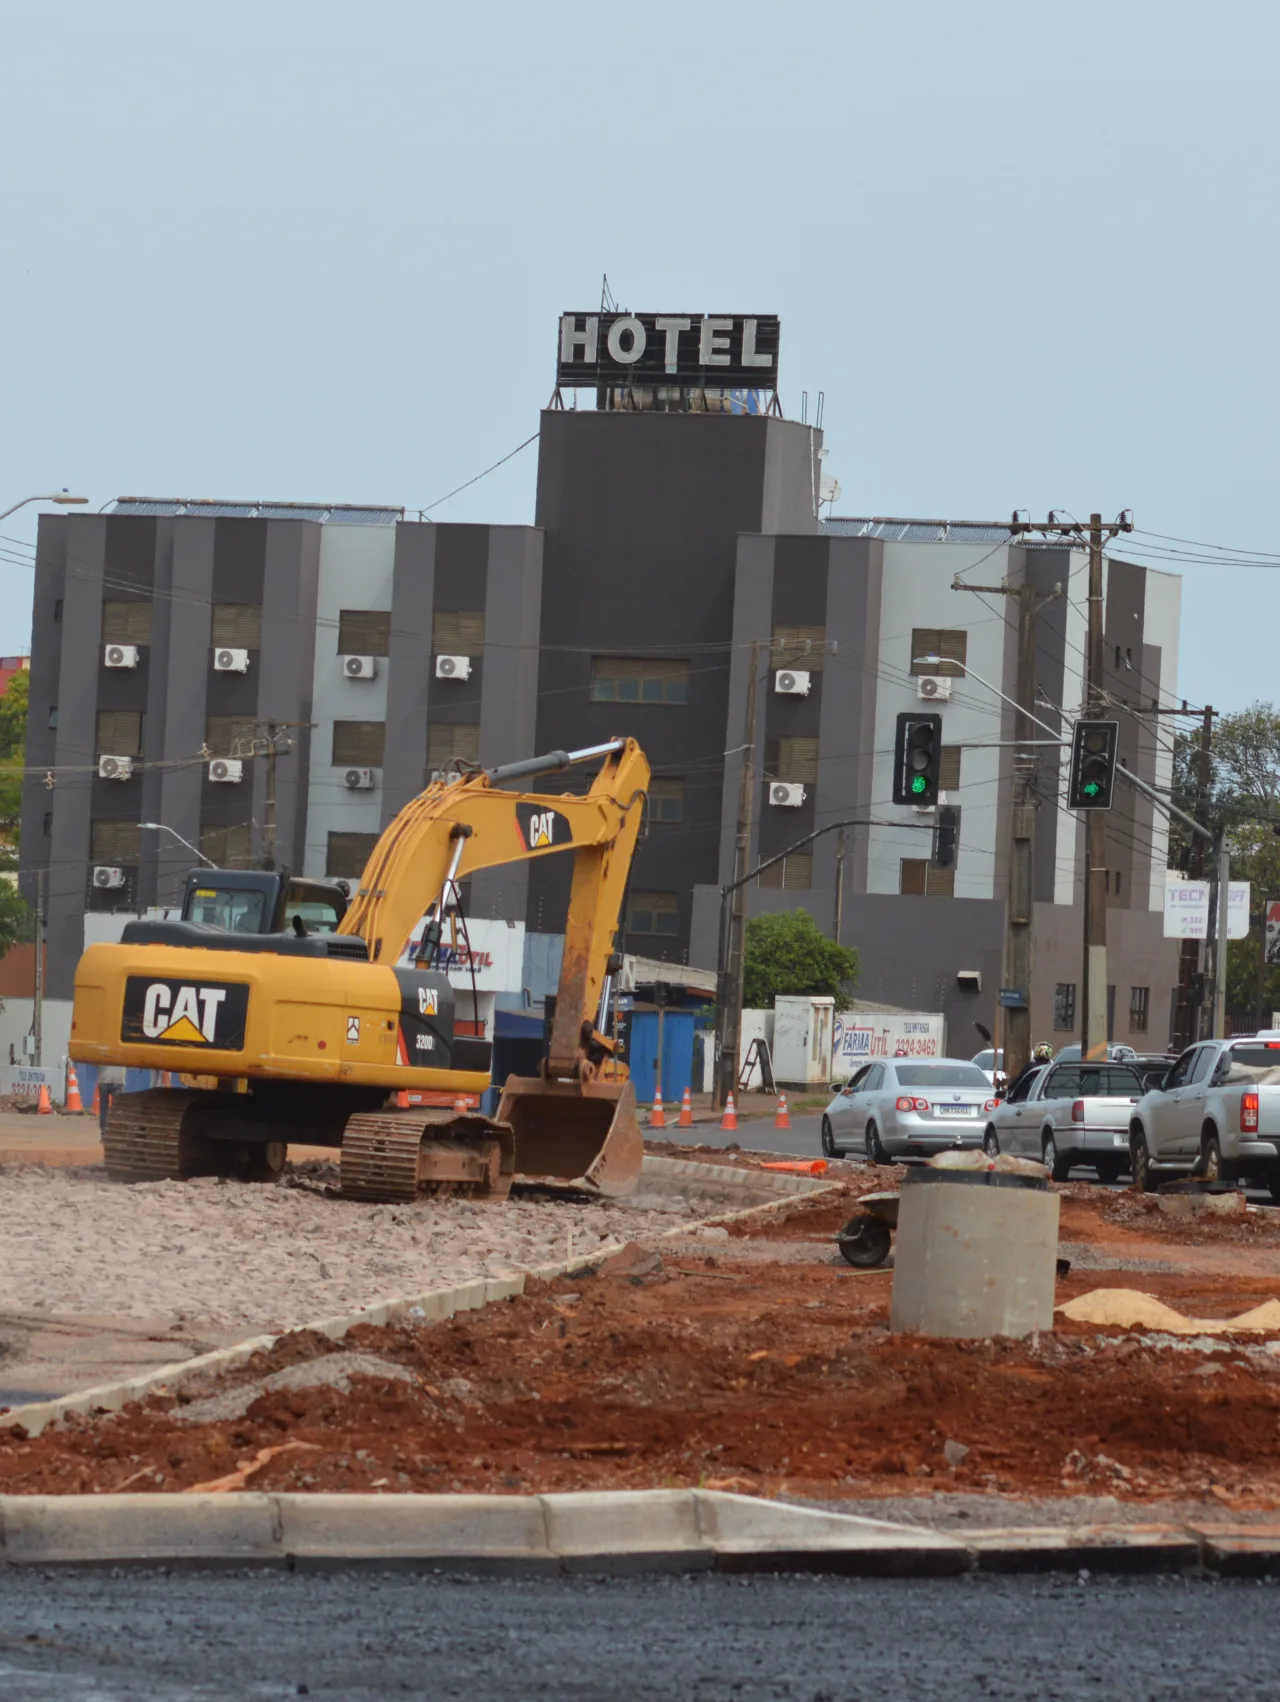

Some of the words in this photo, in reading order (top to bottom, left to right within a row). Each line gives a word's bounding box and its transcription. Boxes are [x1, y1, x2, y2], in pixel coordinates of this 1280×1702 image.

[560, 315, 773, 374] HOTEL
[530, 811, 555, 848] CAT
[142, 983, 227, 1043] CAT
[418, 987, 439, 1015] CAT
[843, 1031, 870, 1051] FARMA
